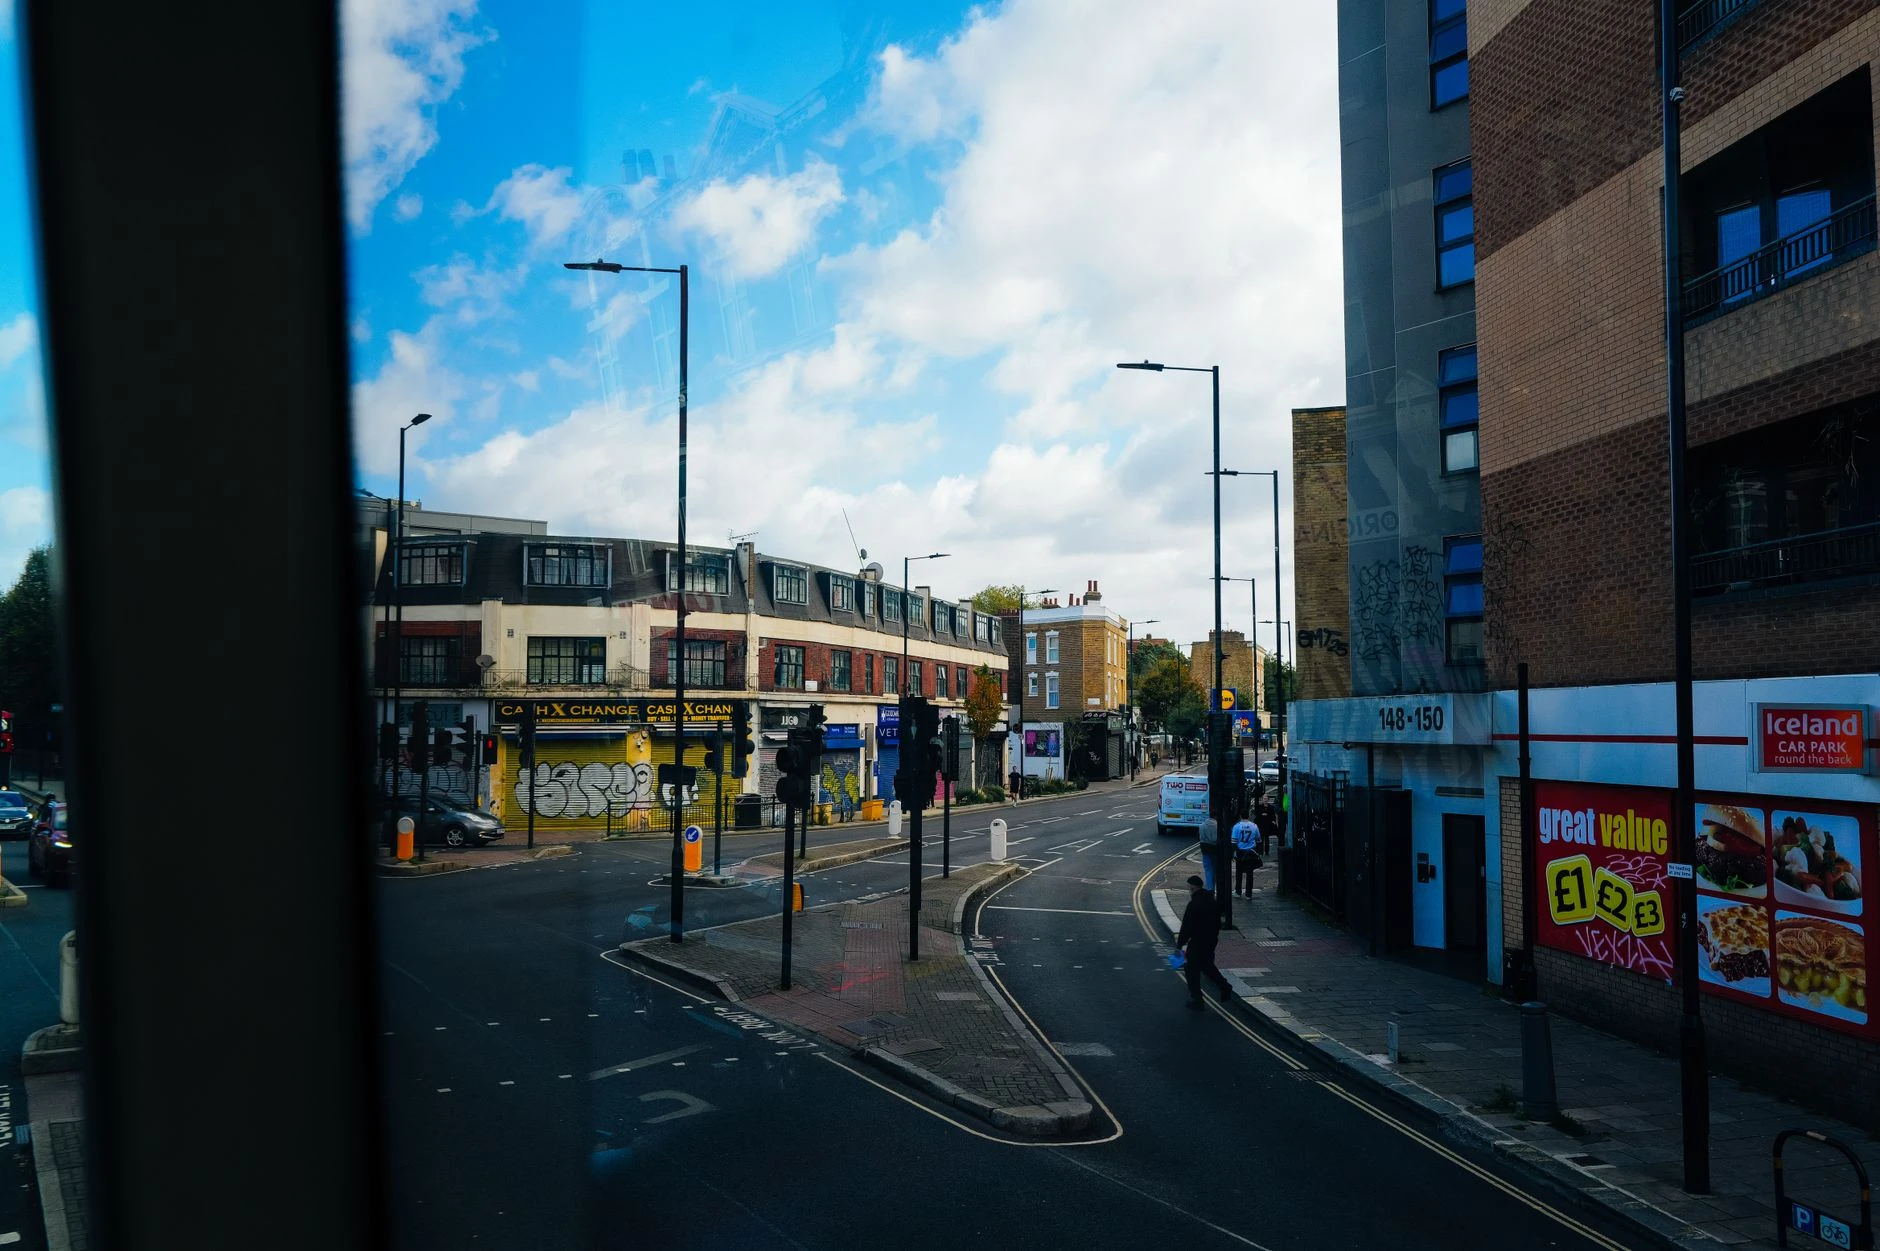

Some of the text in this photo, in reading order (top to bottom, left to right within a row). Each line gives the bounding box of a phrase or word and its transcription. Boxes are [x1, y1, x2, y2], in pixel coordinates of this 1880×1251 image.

[501, 705, 548, 716] CAH
[695, 704, 734, 715] CHAN
[1767, 713, 1858, 737] Iceland
[1778, 741, 1846, 753] CAR PARK
[1774, 754, 1852, 765] round the back
[1240, 830, 1252, 843] 17
[1539, 806, 1668, 855] great value
[1554, 867, 1587, 913] £1
[1596, 879, 1628, 922] £2
[1634, 899, 1660, 929] £3
[1796, 1206, 1811, 1229] P
